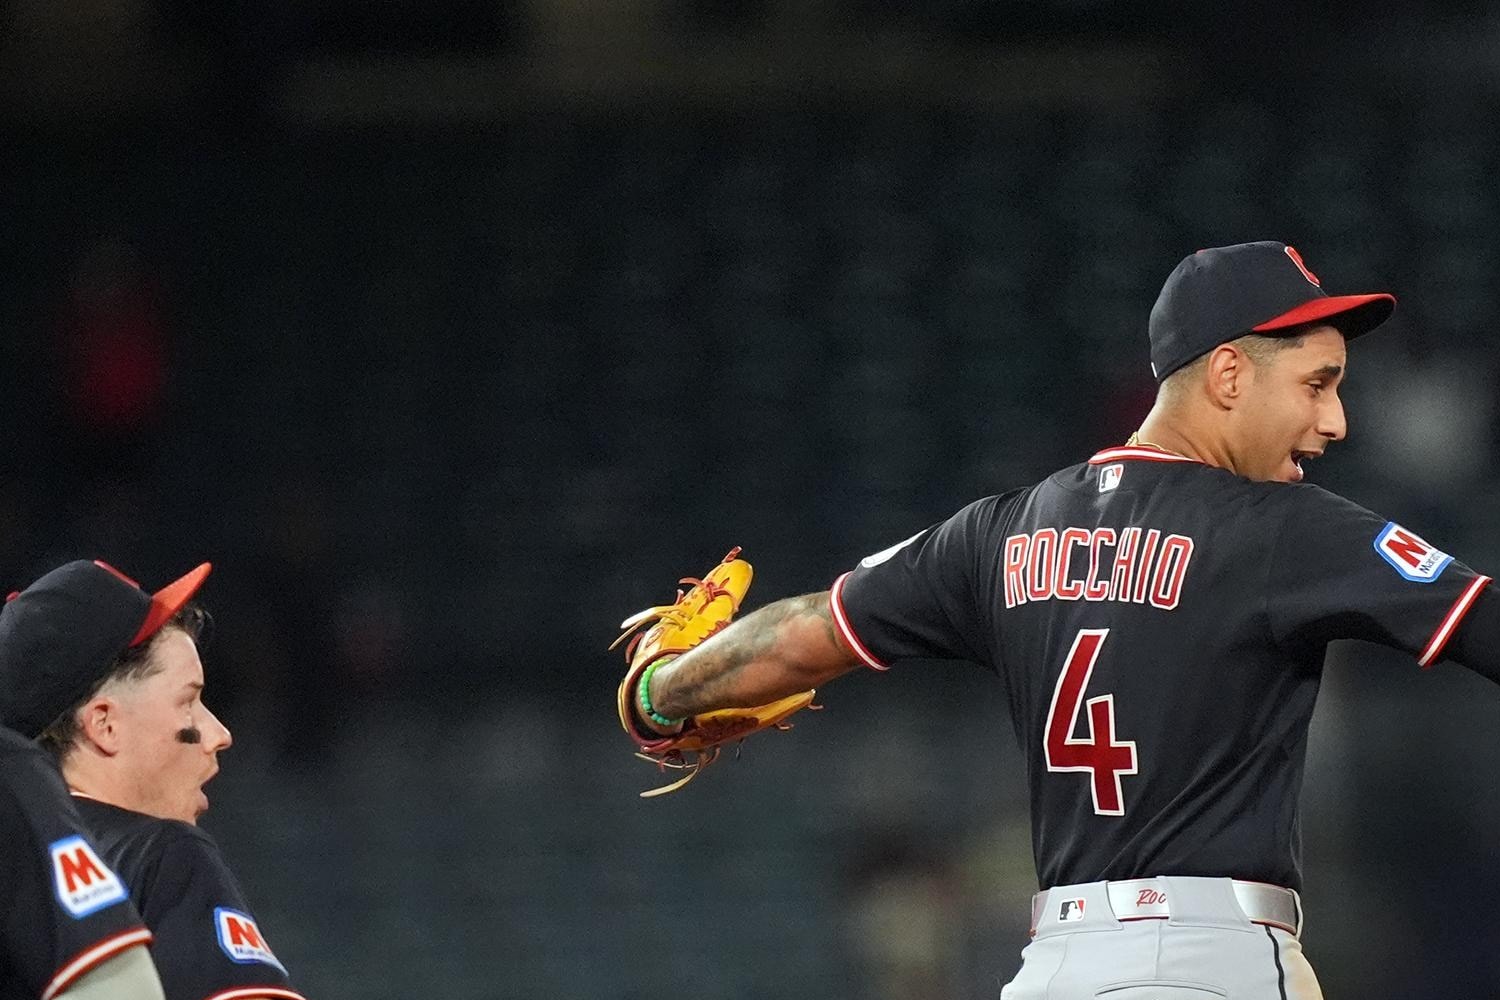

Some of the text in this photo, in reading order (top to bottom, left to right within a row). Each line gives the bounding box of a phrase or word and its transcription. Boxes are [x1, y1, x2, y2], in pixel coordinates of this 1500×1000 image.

[1003, 527, 1194, 610] ROCCHIO
[1043, 628, 1138, 816] 4
[58, 847, 107, 893] M
